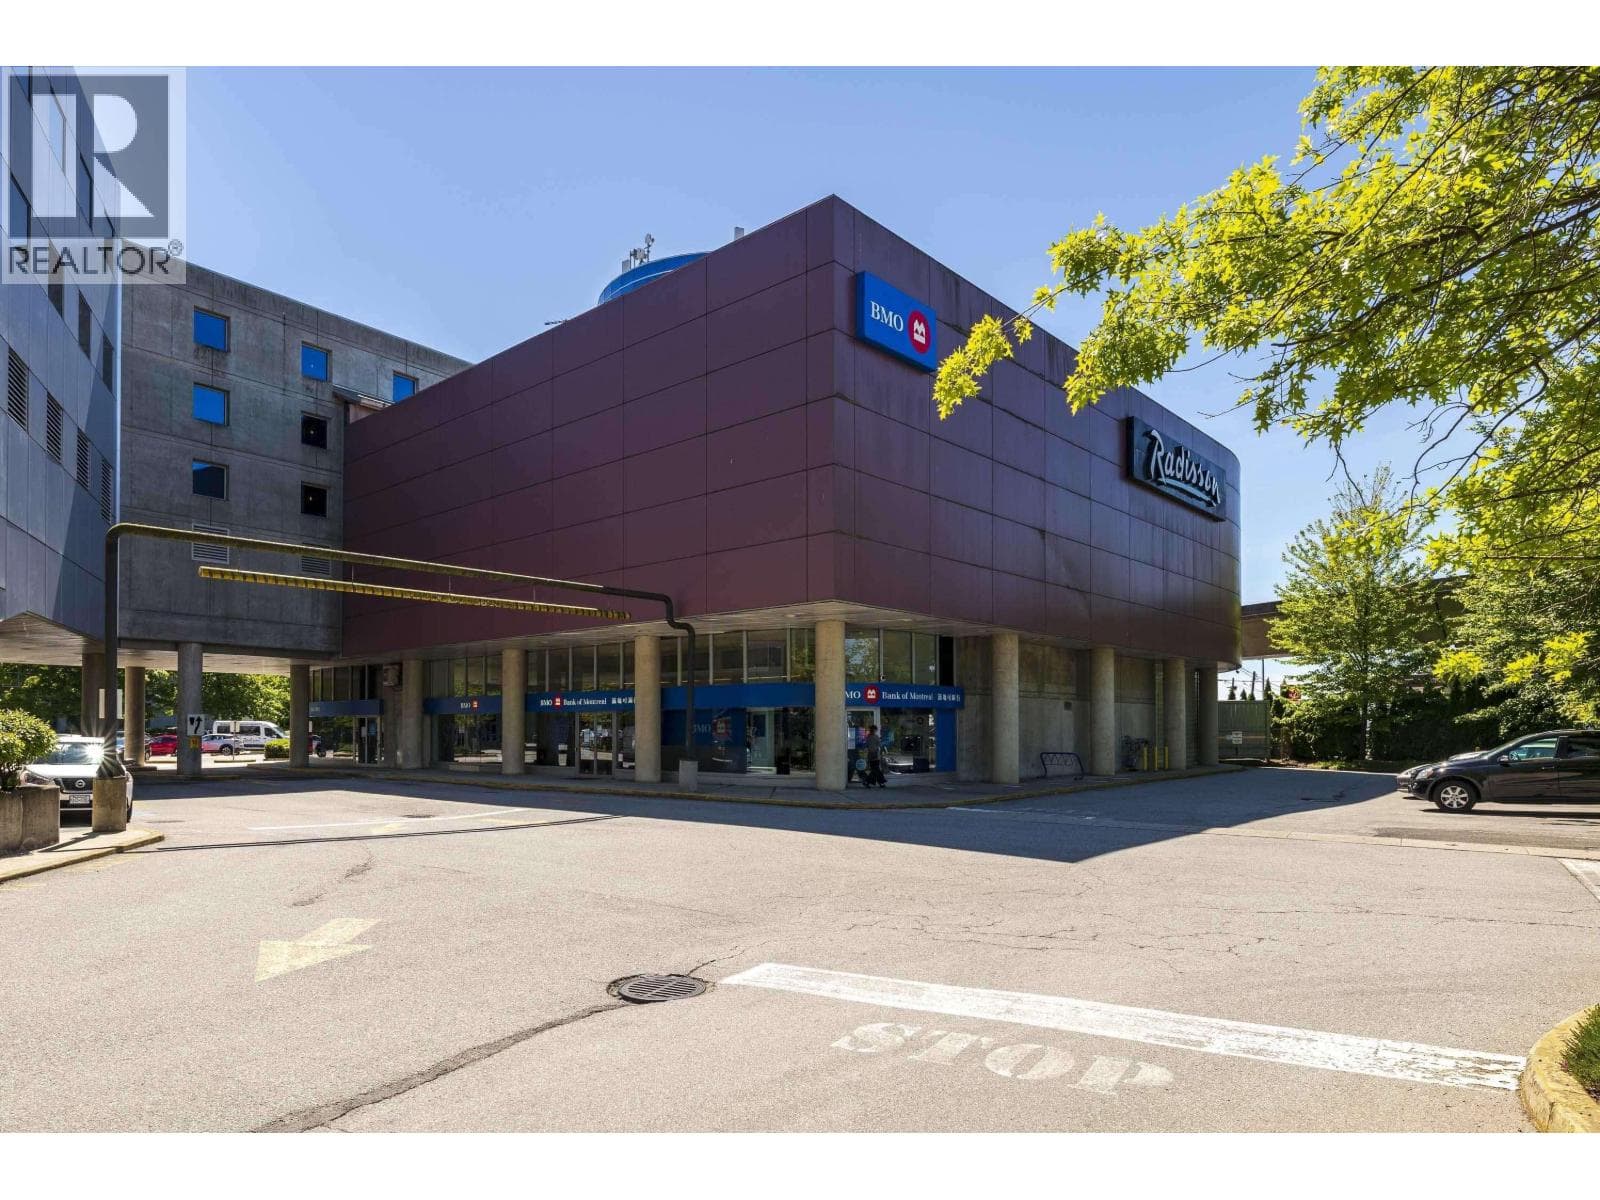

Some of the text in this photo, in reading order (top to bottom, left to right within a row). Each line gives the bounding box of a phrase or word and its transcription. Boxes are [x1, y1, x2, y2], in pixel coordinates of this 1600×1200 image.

[870, 301, 904, 332] BMO
[1150, 429, 1221, 505] Radisson
[563, 697, 576, 706] Bank
[576, 697, 583, 705] of
[583, 697, 607, 705] Montreal
[845, 690, 861, 700] MO
[882, 691, 901, 700] Bank
[901, 691, 908, 700] of
[910, 691, 934, 701] Montreal
[830, 1022, 1175, 1096] STOP
